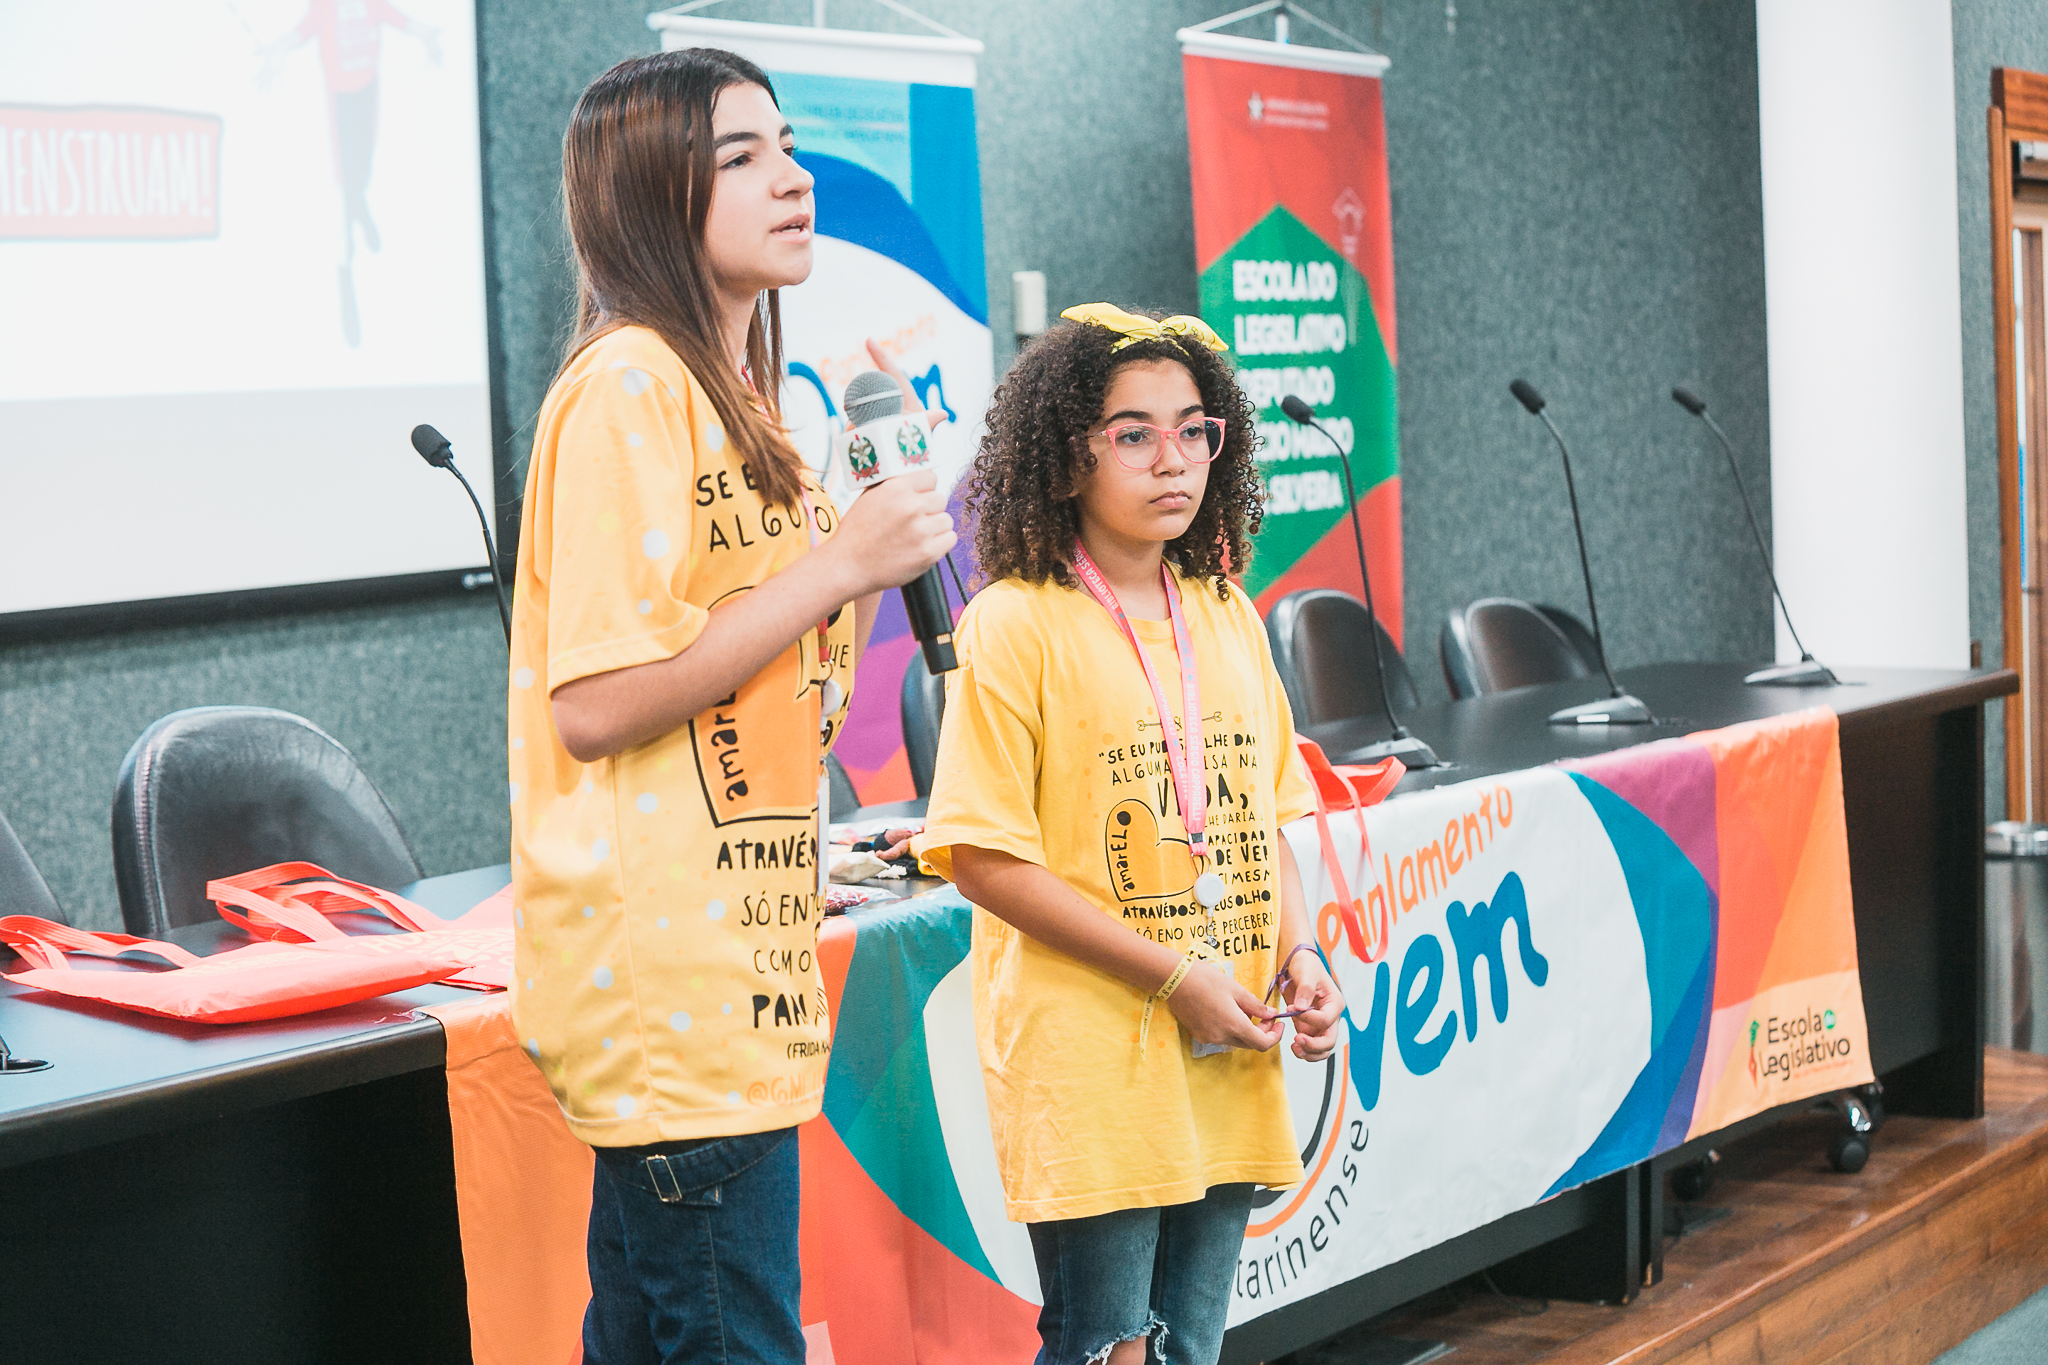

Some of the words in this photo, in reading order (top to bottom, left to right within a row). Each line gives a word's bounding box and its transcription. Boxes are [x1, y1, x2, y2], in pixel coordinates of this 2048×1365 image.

[1233, 259, 1309, 301] ESCOLA
[1234, 314, 1347, 355] LEGISLATIVO
[696, 470, 733, 507] SE
[1085, 566, 1119, 610] BIBLIOTECA
[1186, 683, 1198, 733] BIBLIOTECA
[1131, 743, 1146, 757] EU
[1204, 733, 1228, 749] LHE
[1112, 758, 1172, 787] ALGUMA
[1239, 753, 1257, 769] NA
[1191, 768, 1202, 821] CAPPARELLI
[1223, 811, 1255, 824] DARIA
[1208, 830, 1265, 847] APACIDAD
[1216, 849, 1233, 866] DE
[741, 889, 771, 927] SÓ
[1235, 889, 1271, 907] OLHO
[1222, 911, 1274, 935] PERCEBERI
[753, 949, 811, 976] COMO
[1221, 933, 1271, 957] ECIAL
[1767, 1005, 1822, 1044] Escola
[1758, 1034, 1851, 1081] Legislativo
[1236, 1119, 1369, 1300] tarinense
